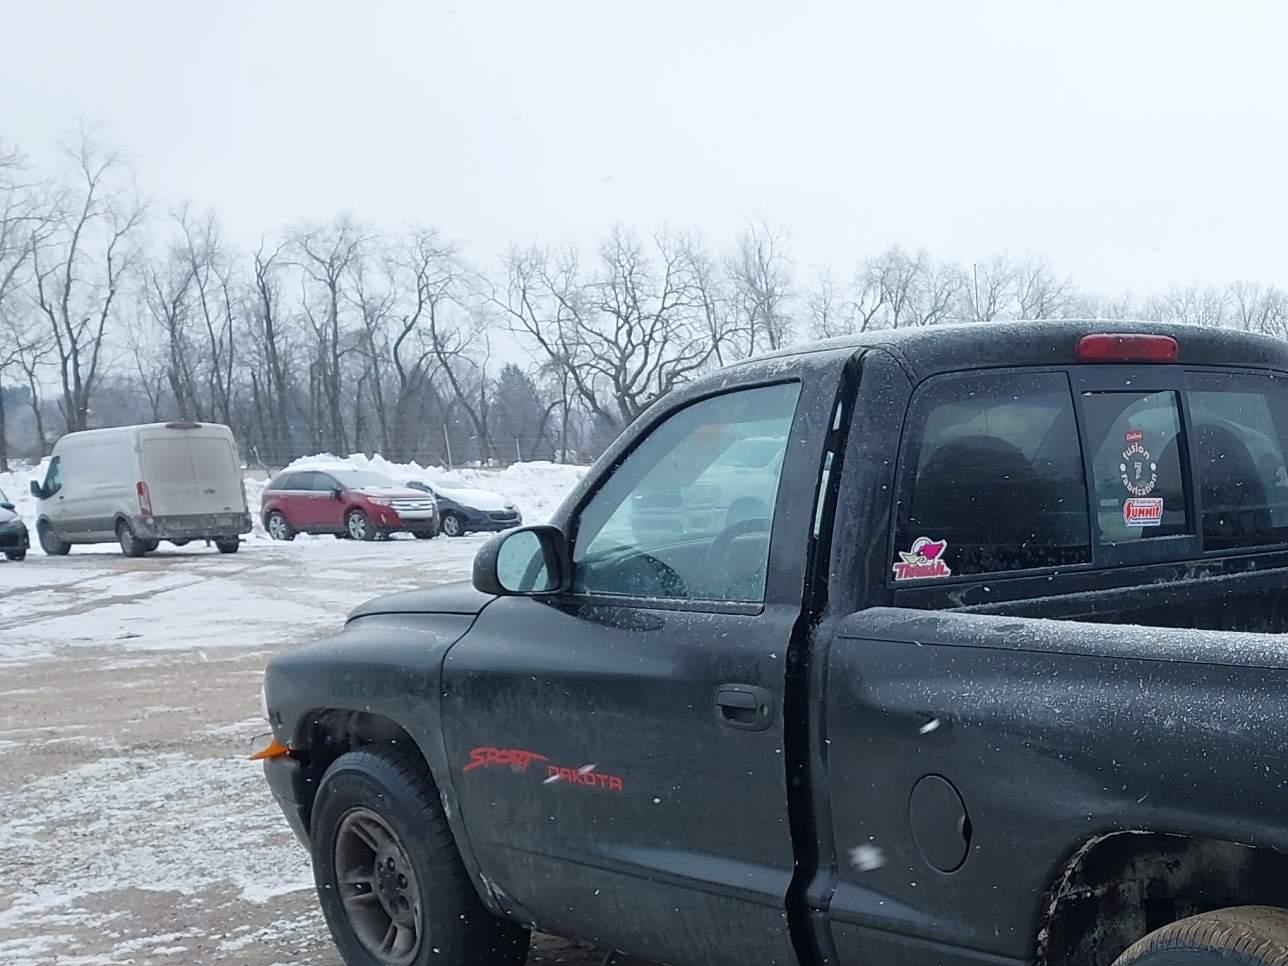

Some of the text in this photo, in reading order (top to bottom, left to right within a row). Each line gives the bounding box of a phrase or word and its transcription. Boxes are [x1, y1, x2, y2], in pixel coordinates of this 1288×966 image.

[1126, 500, 1160, 520] SUMMIT
[463, 746, 550, 773] SPORT
[545, 765, 623, 791] DAKOTA
